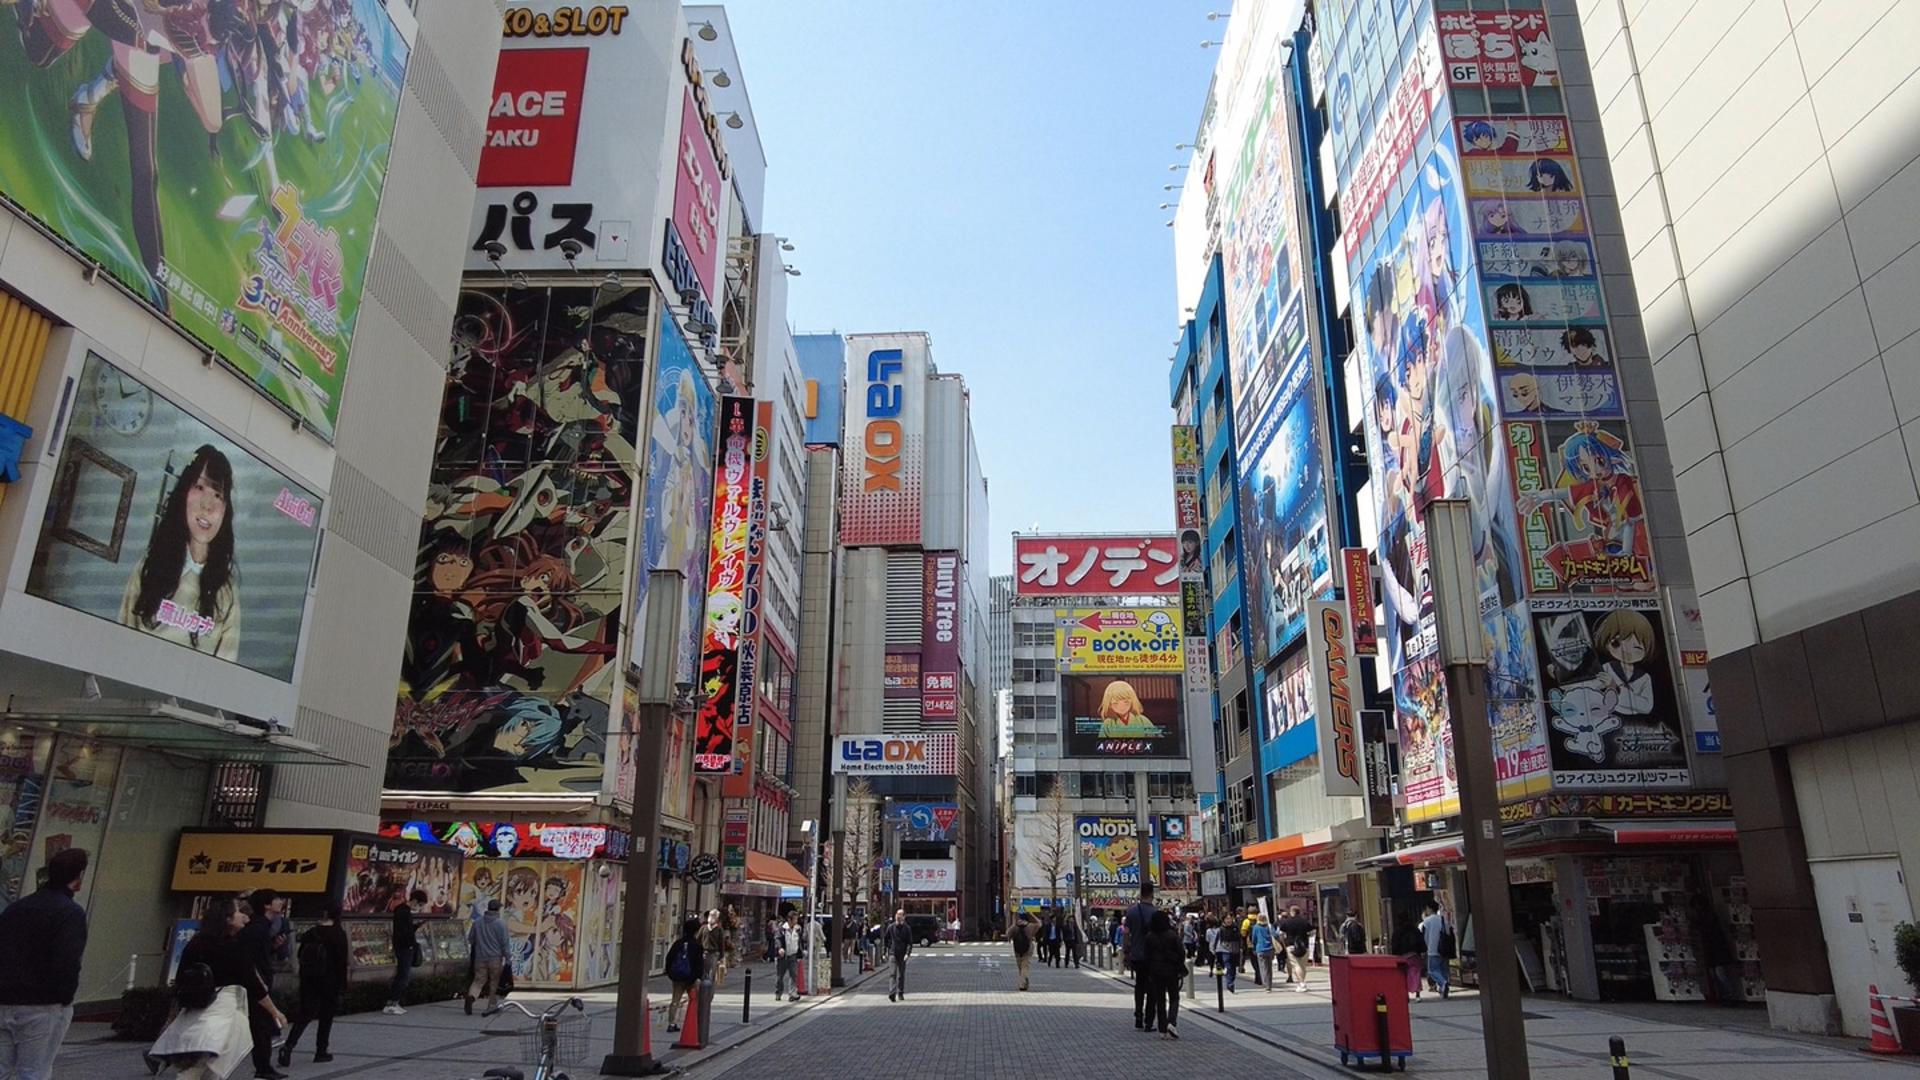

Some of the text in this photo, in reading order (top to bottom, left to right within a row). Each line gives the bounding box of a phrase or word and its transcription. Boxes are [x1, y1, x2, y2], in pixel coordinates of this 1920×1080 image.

[1440, 14, 1544, 31] ホビーランド
[1442, 32, 1516, 60] ぽち
[1452, 66, 1478, 81] 6F
[488, 91, 567, 118] ACE
[240, 274, 282, 316] 3rd
[279, 303, 337, 368] Anniversary
[1020, 539, 1180, 588] オノデン
[935, 557, 956, 642] Duty Free
[926, 675, 953, 689] 免税
[1322, 607, 1360, 786] GAMERS
[1097, 742, 1153, 751] ANIPLEX
[840, 763, 927, 771] Home Electronics Store
[416, 801, 450, 810] ESPACE
[217, 858, 318, 875] 銀座ライオン
